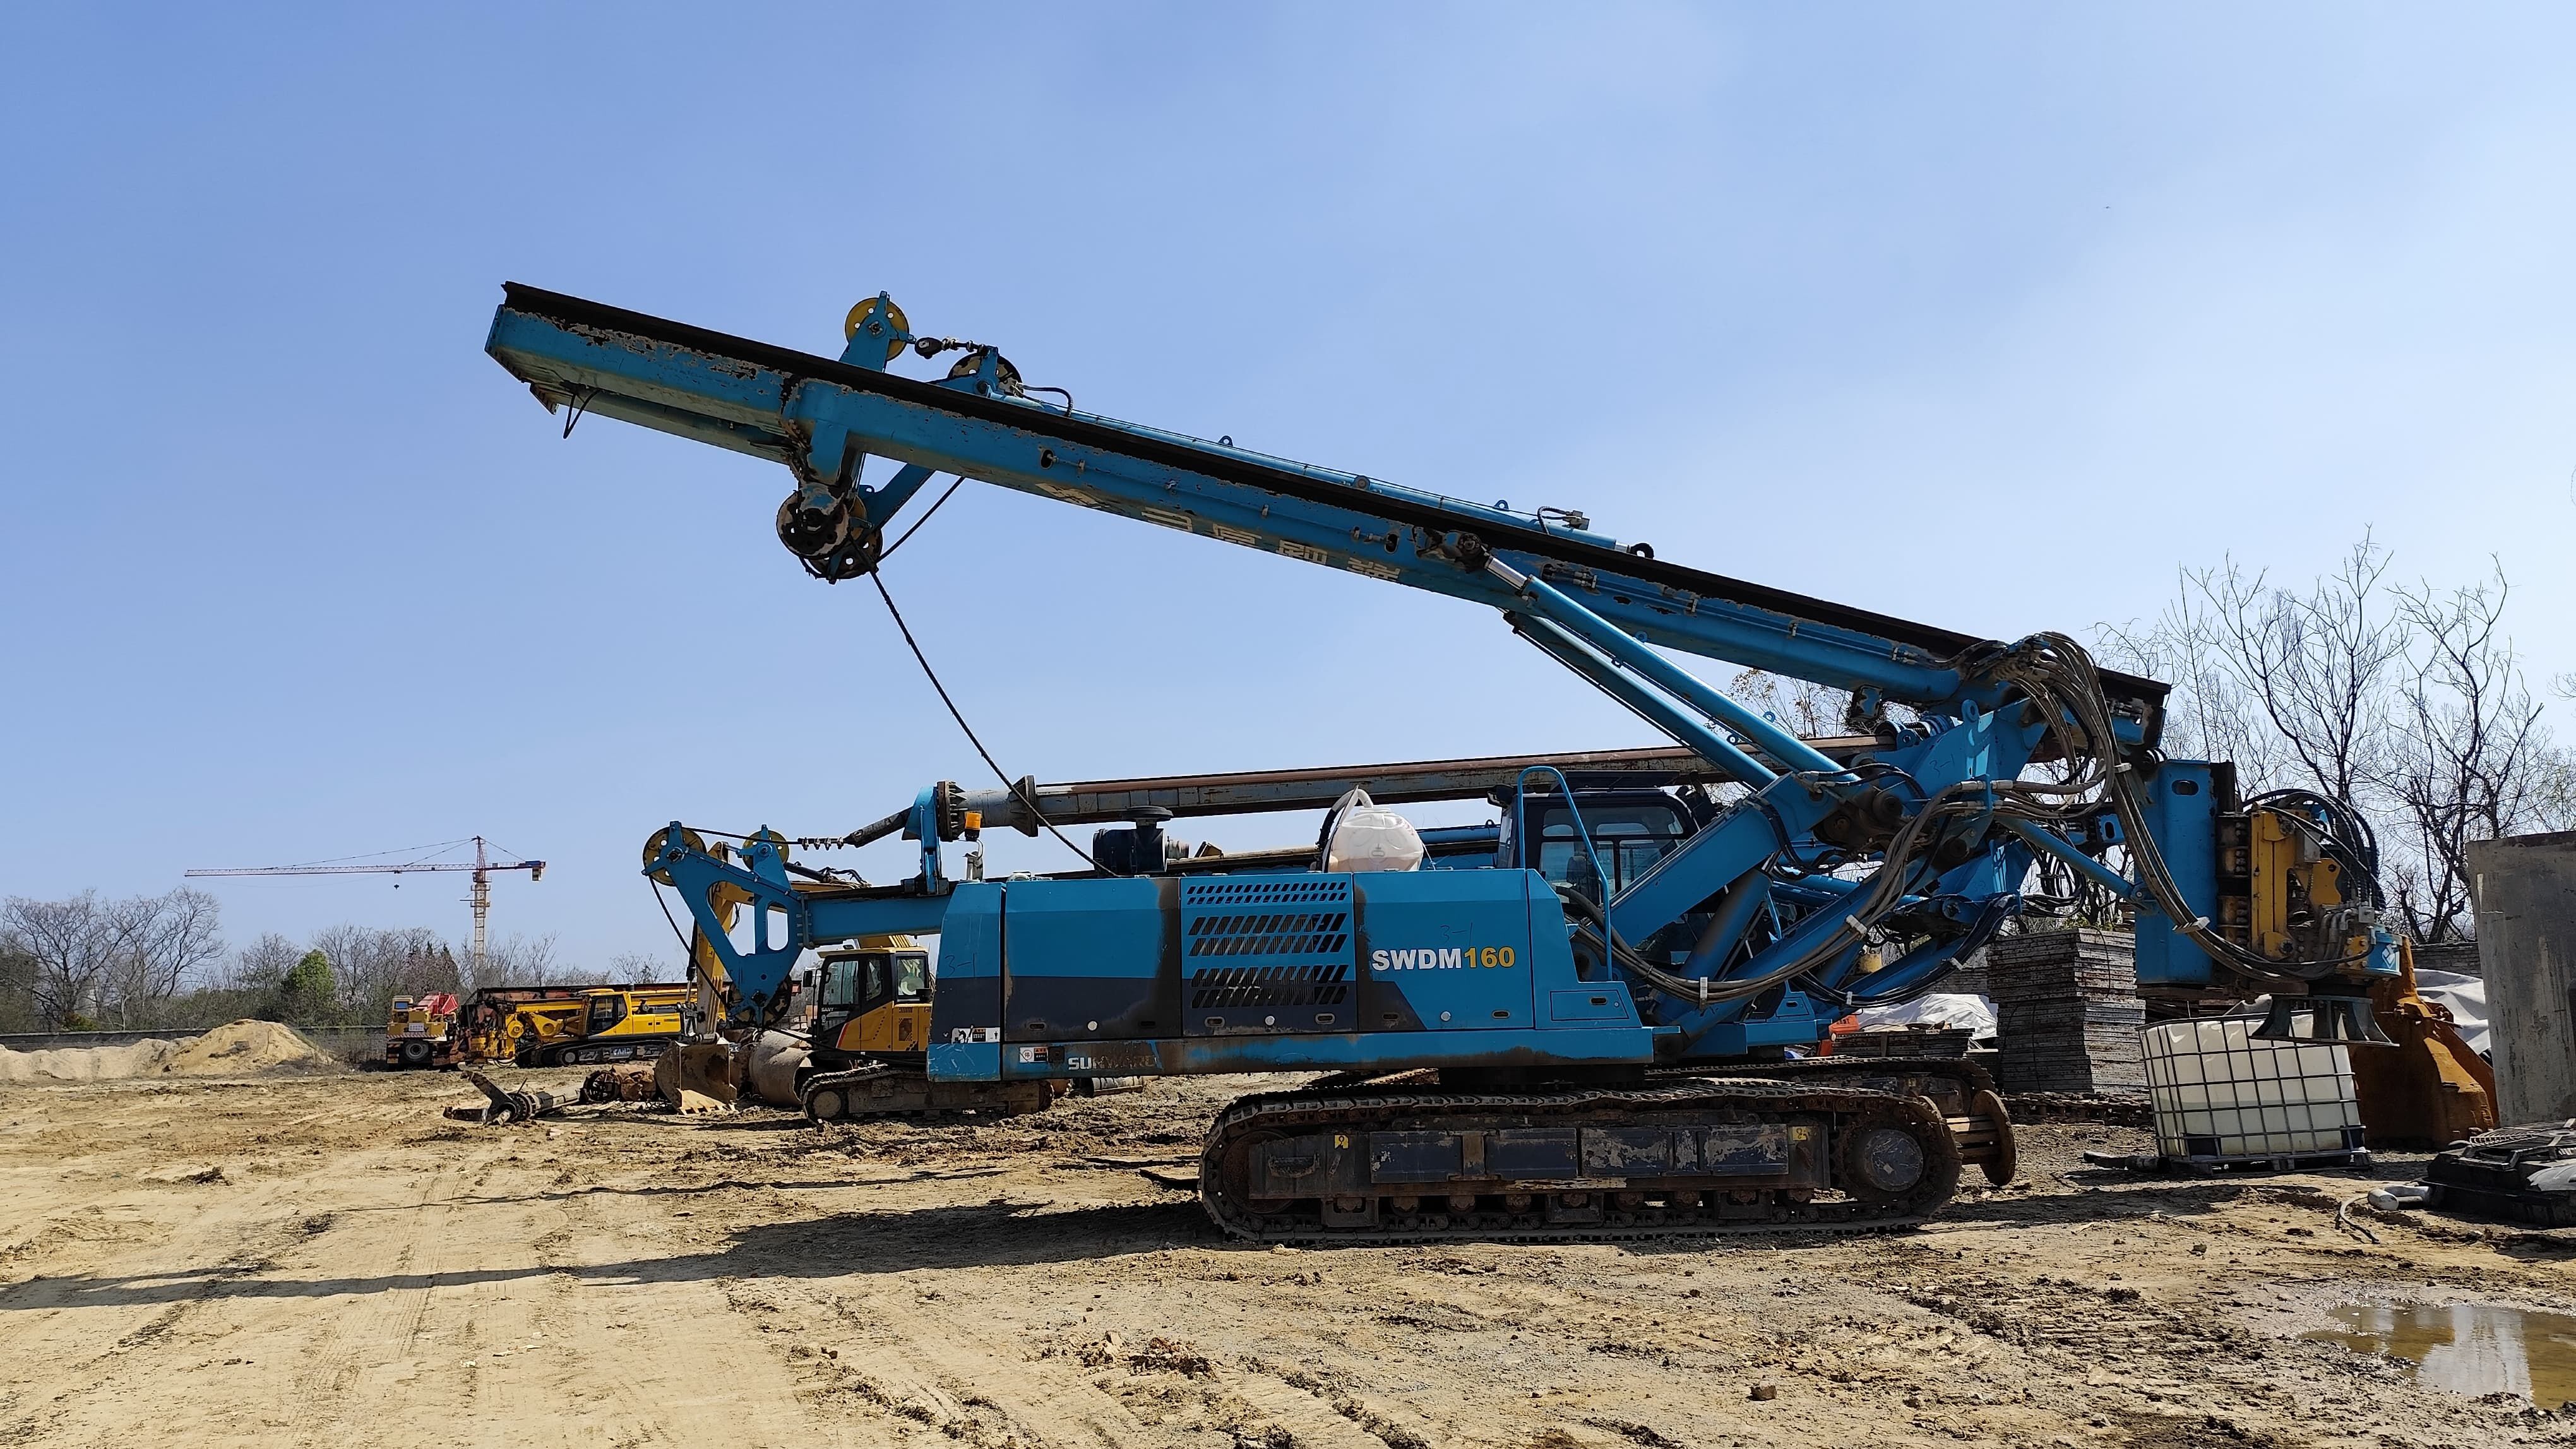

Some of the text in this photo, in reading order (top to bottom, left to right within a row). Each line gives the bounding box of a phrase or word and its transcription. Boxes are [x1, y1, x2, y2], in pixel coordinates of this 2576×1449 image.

[1440, 921, 1473, 946] 3-1
[944, 952, 975, 978] 3-1
[1371, 946, 1515, 971] SWDM160
